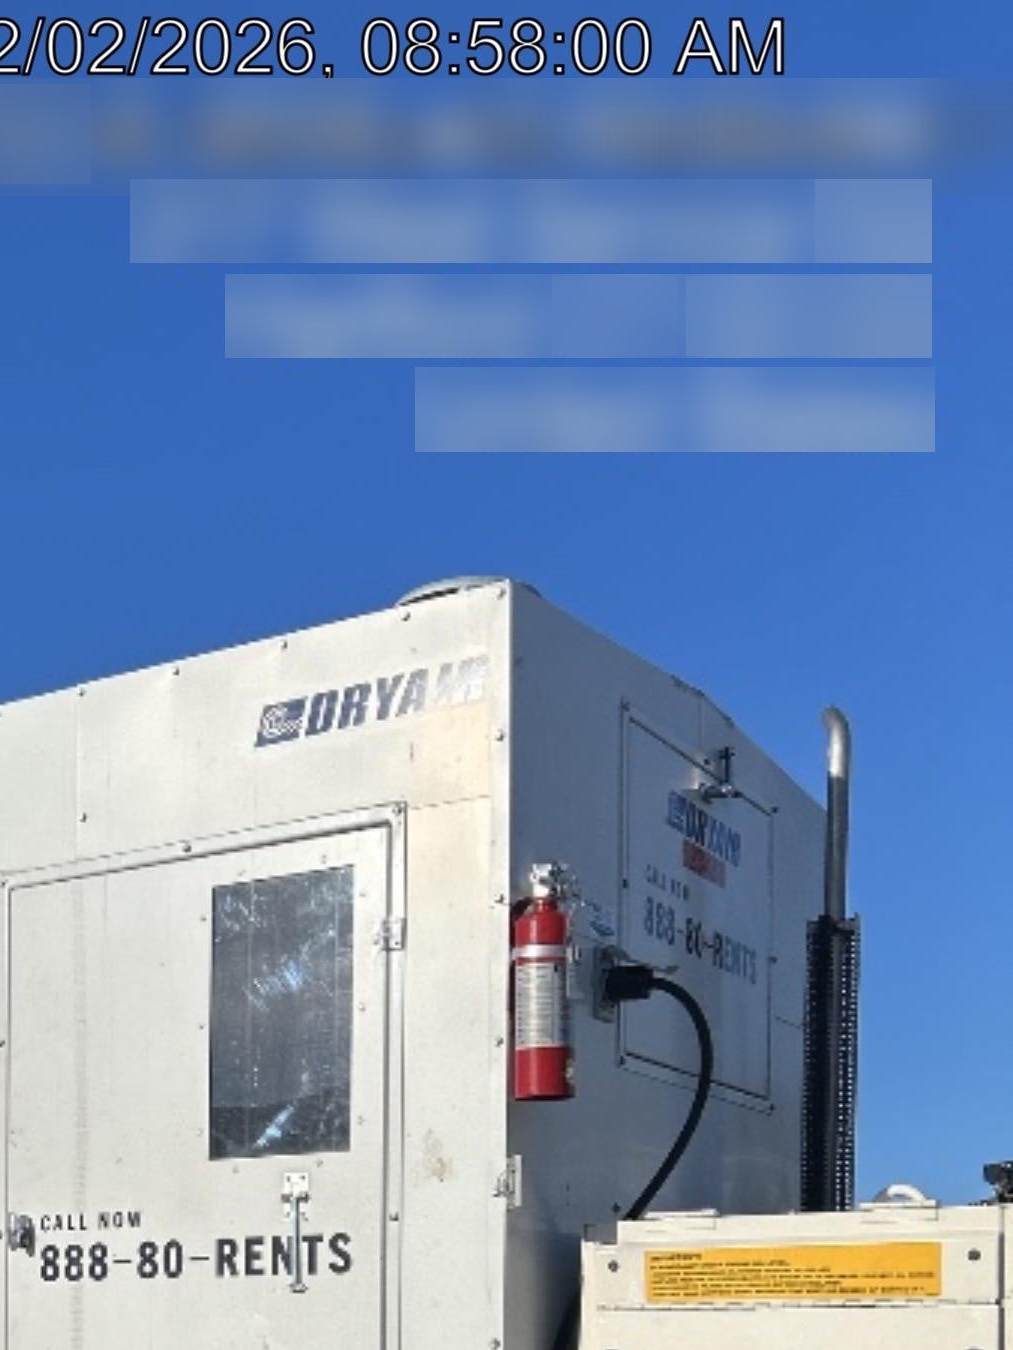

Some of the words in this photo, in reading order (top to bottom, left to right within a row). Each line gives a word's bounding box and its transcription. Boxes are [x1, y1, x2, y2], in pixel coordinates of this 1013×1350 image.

[40, 1211, 87, 1231] CALL
[97, 1211, 142, 1230] NOW
[41, 1232, 353, 1281] 888-80-RENTS
